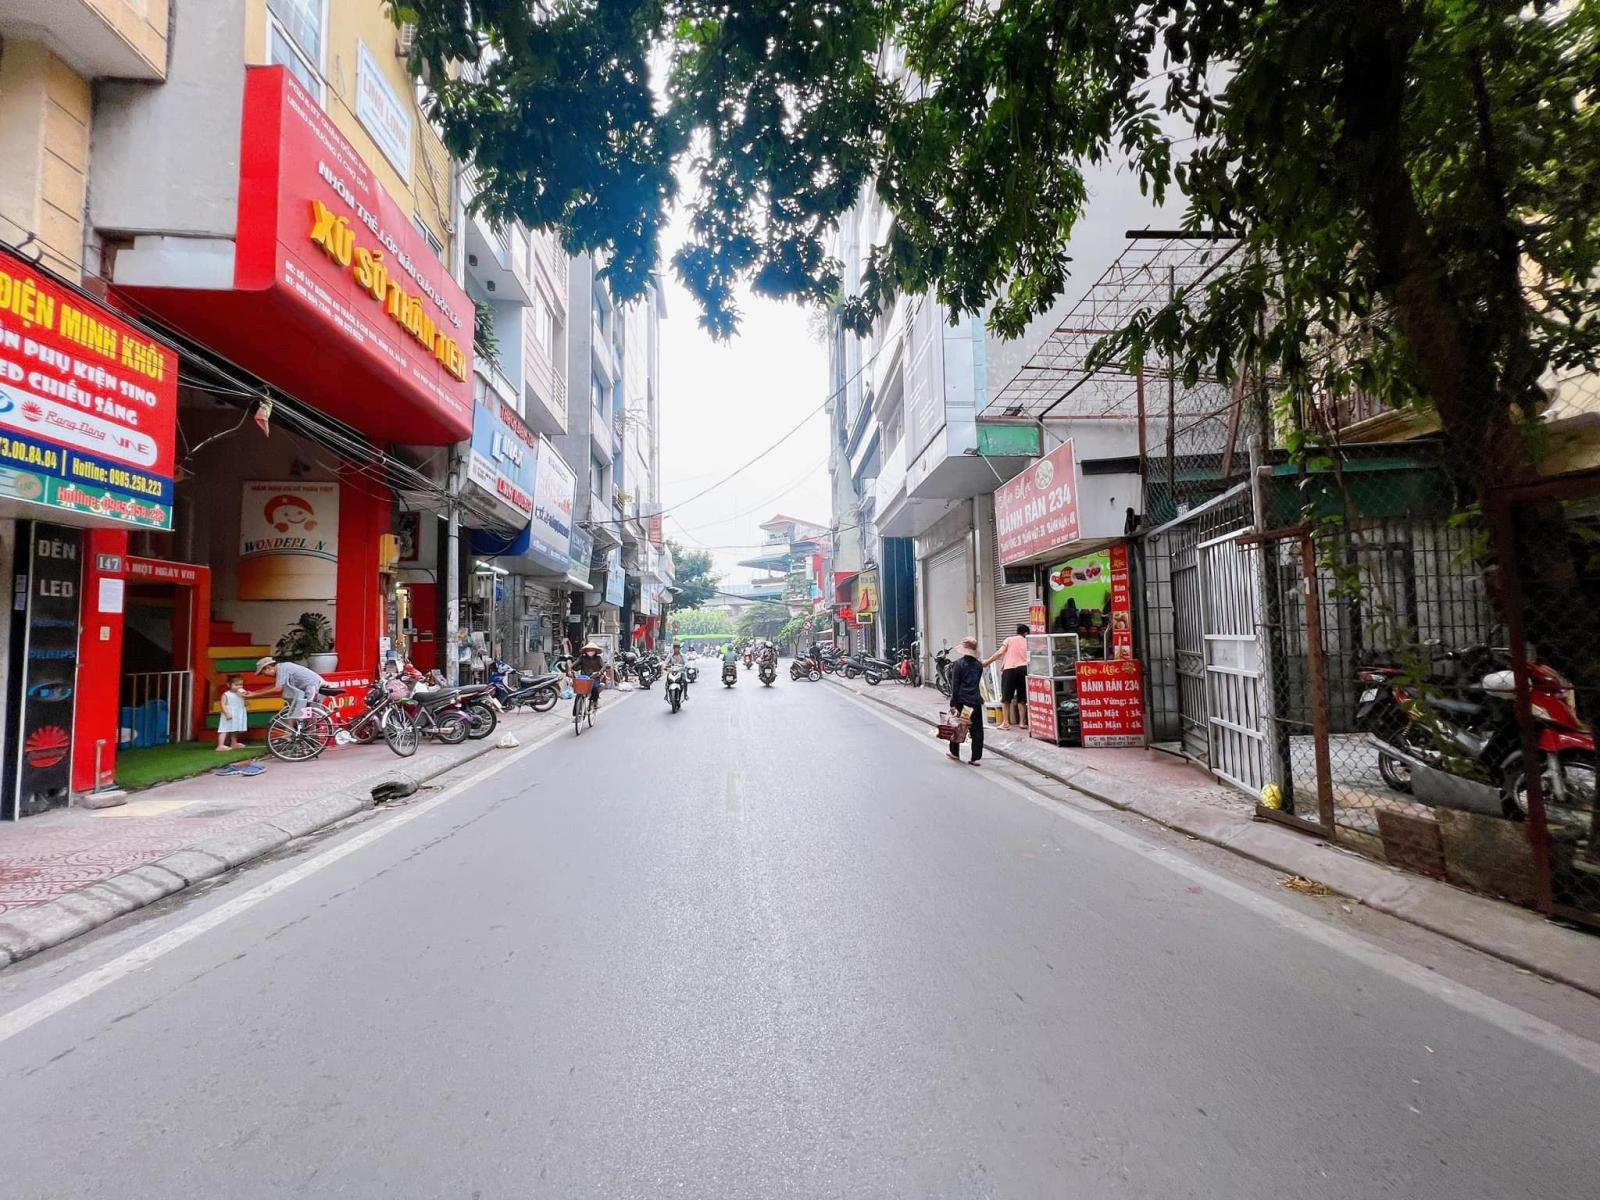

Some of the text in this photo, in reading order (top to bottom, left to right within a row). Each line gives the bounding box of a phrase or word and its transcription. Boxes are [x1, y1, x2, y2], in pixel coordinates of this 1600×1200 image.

[318, 160, 355, 208] NHÓM
[310, 200, 356, 267] XỨ
[352, 246, 388, 302] SỞ
[385, 278, 437, 352] THẦN
[434, 328, 466, 384] TIÊN
[60, 302, 118, 360] MINH
[121, 334, 165, 382] KHÔI
[24, 336, 71, 374] PHỤ
[73, 360, 117, 390] KIỆN
[120, 381, 157, 407] SINO
[28, 371, 92, 408] CHIẾU
[95, 397, 138, 425] SÁNG
[0, 436, 57, 469] 3.00.84.84
[72, 457, 108, 483] Hotline:
[1000, 483, 1072, 536] BÁNH RÁN 234
[99, 556, 120, 571] 147
[40, 579, 74, 598] LED
[1081, 677, 1139, 692] BÁNH RÁN 234
[1081, 698, 1101, 706] Bánh
[1082, 709, 1102, 718] Bánh
[1083, 721, 1103, 730] Bánh
